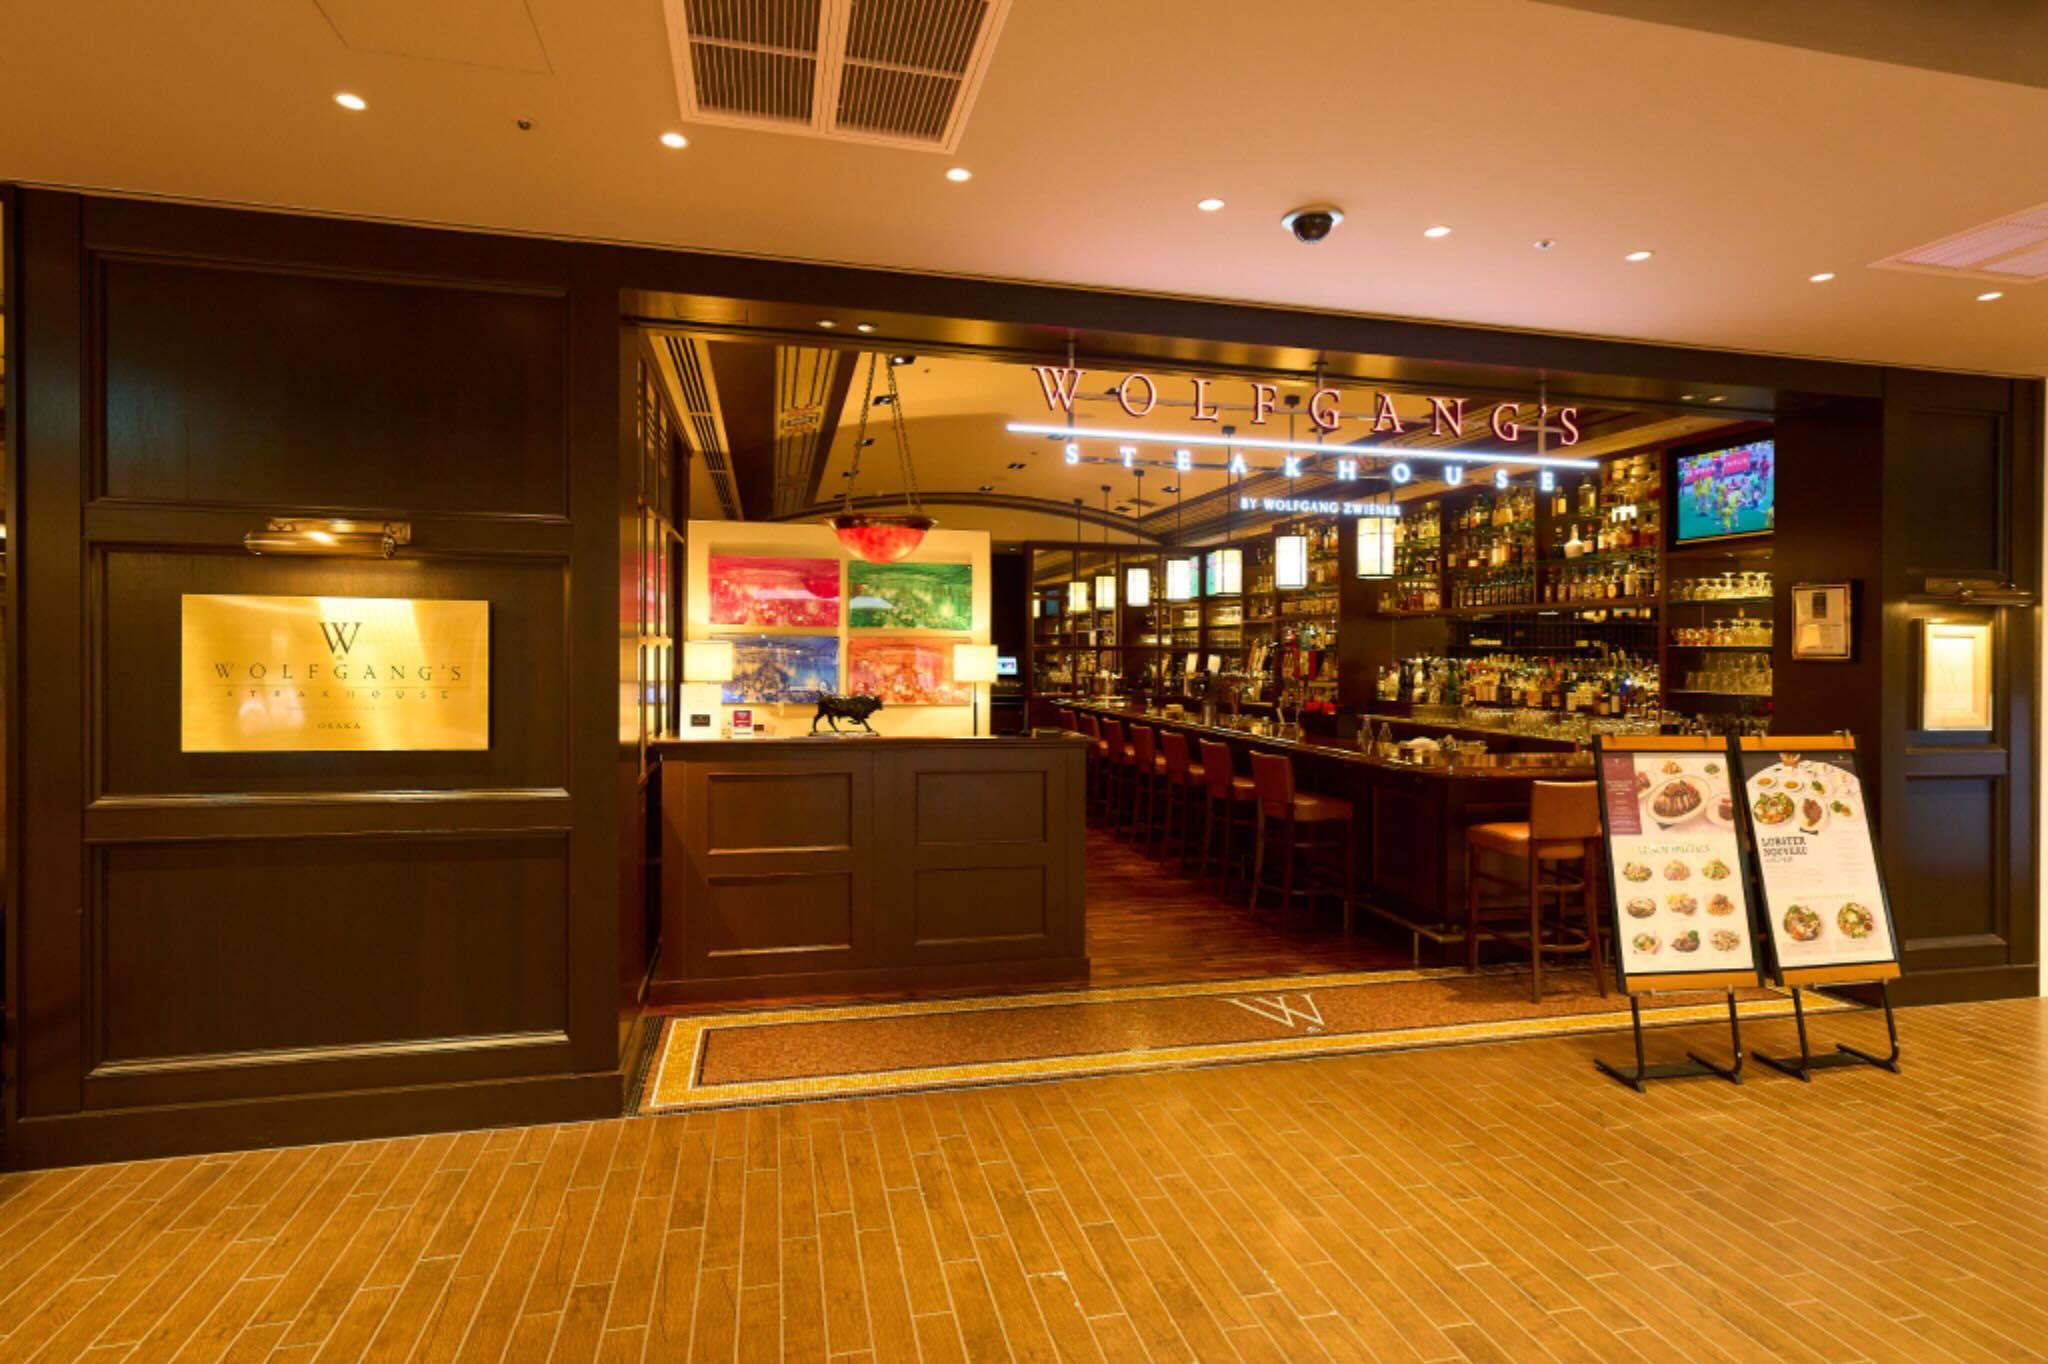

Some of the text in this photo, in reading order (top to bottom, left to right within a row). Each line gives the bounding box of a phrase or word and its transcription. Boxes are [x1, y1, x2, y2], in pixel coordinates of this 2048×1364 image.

[1032, 365, 1580, 447] WOLFGANG'S
[1064, 442, 1556, 493] STEAKHOUSE
[1240, 497, 1401, 517] BY WOLFGANG ZWIENER
[319, 622, 363, 655] W
[215, 662, 462, 682] WOLFGANG'S
[316, 722, 361, 730] OSAKA
[1218, 993, 1325, 1028] W
